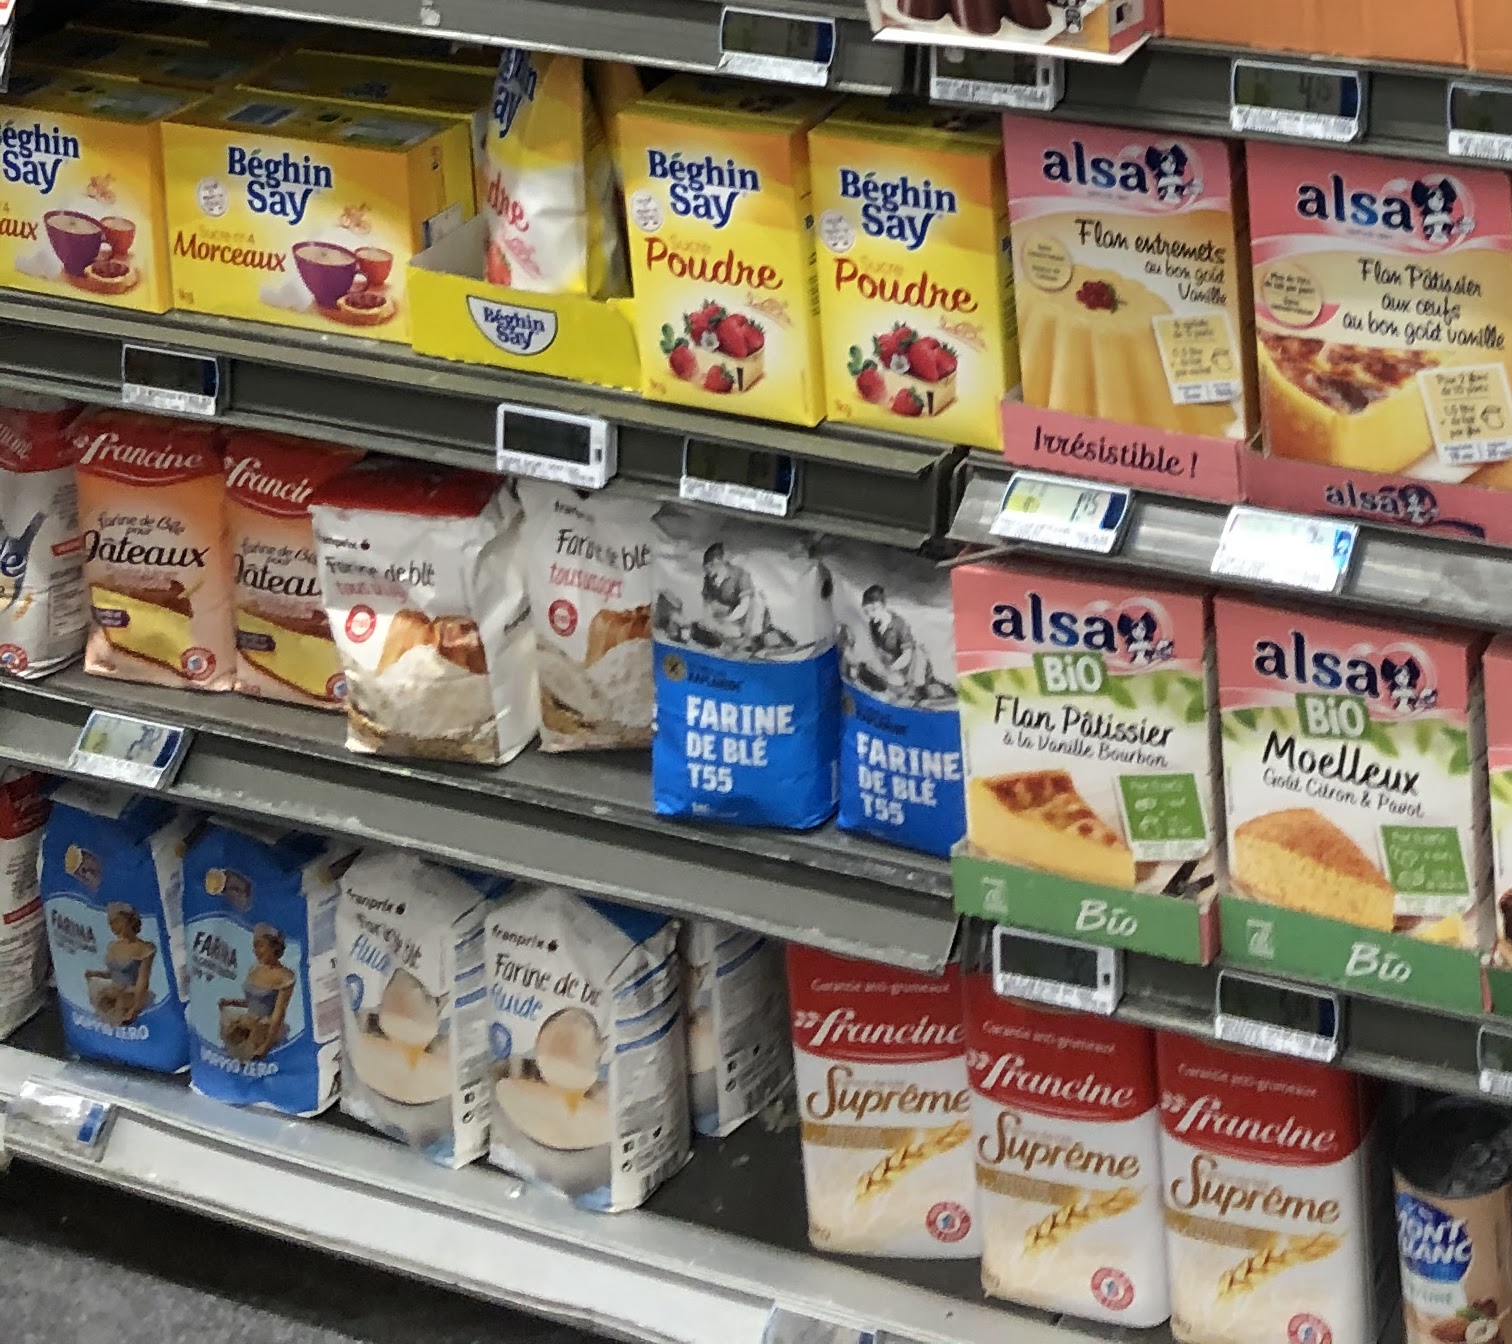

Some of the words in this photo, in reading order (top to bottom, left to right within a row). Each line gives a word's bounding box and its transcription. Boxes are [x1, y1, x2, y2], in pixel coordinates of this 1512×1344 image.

[226, 146, 333, 189] Béghin
[646, 148, 761, 193] Béghin
[840, 167, 957, 215] Béghin
[1041, 140, 1148, 196] alsa
[246, 181, 313, 227] Say
[668, 182, 738, 229] Say
[1296, 171, 1413, 236] alsa
[862, 205, 935, 252] Say
[1074, 217, 1129, 251] Flan
[1135, 231, 1226, 264] entremets
[173, 229, 287, 276] Morceaux
[644, 235, 785, 293] Poudre
[833, 257, 980, 316] Poudre
[1357, 258, 1402, 286] Flan
[1405, 263, 1483, 298] Pâtissier
[482, 306, 546, 335] Béghin
[494, 325, 534, 352] Say
[990, 592, 1116, 655] alsa
[1253, 632, 1380, 697] alsa
[685, 696, 795, 736] FARINE
[993, 695, 1056, 736] Flan
[1061, 708, 1177, 750] Pâtissier
[685, 732, 718, 761] DE
[722, 730, 768, 766] BLÉ
[856, 732, 961, 782] FARINE
[1261, 730, 1421, 800] Moelleux
[687, 763, 735, 796] T55
[857, 765, 894, 798] DE
[895, 774, 938, 808] BLÉ
[1074, 898, 1140, 938] Bio
[1344, 942, 1413, 986] Bio
[805, 1067, 974, 1122] Suprême
[977, 1111, 1142, 1181] Suprême
[1169, 1153, 1343, 1227] Suprême
